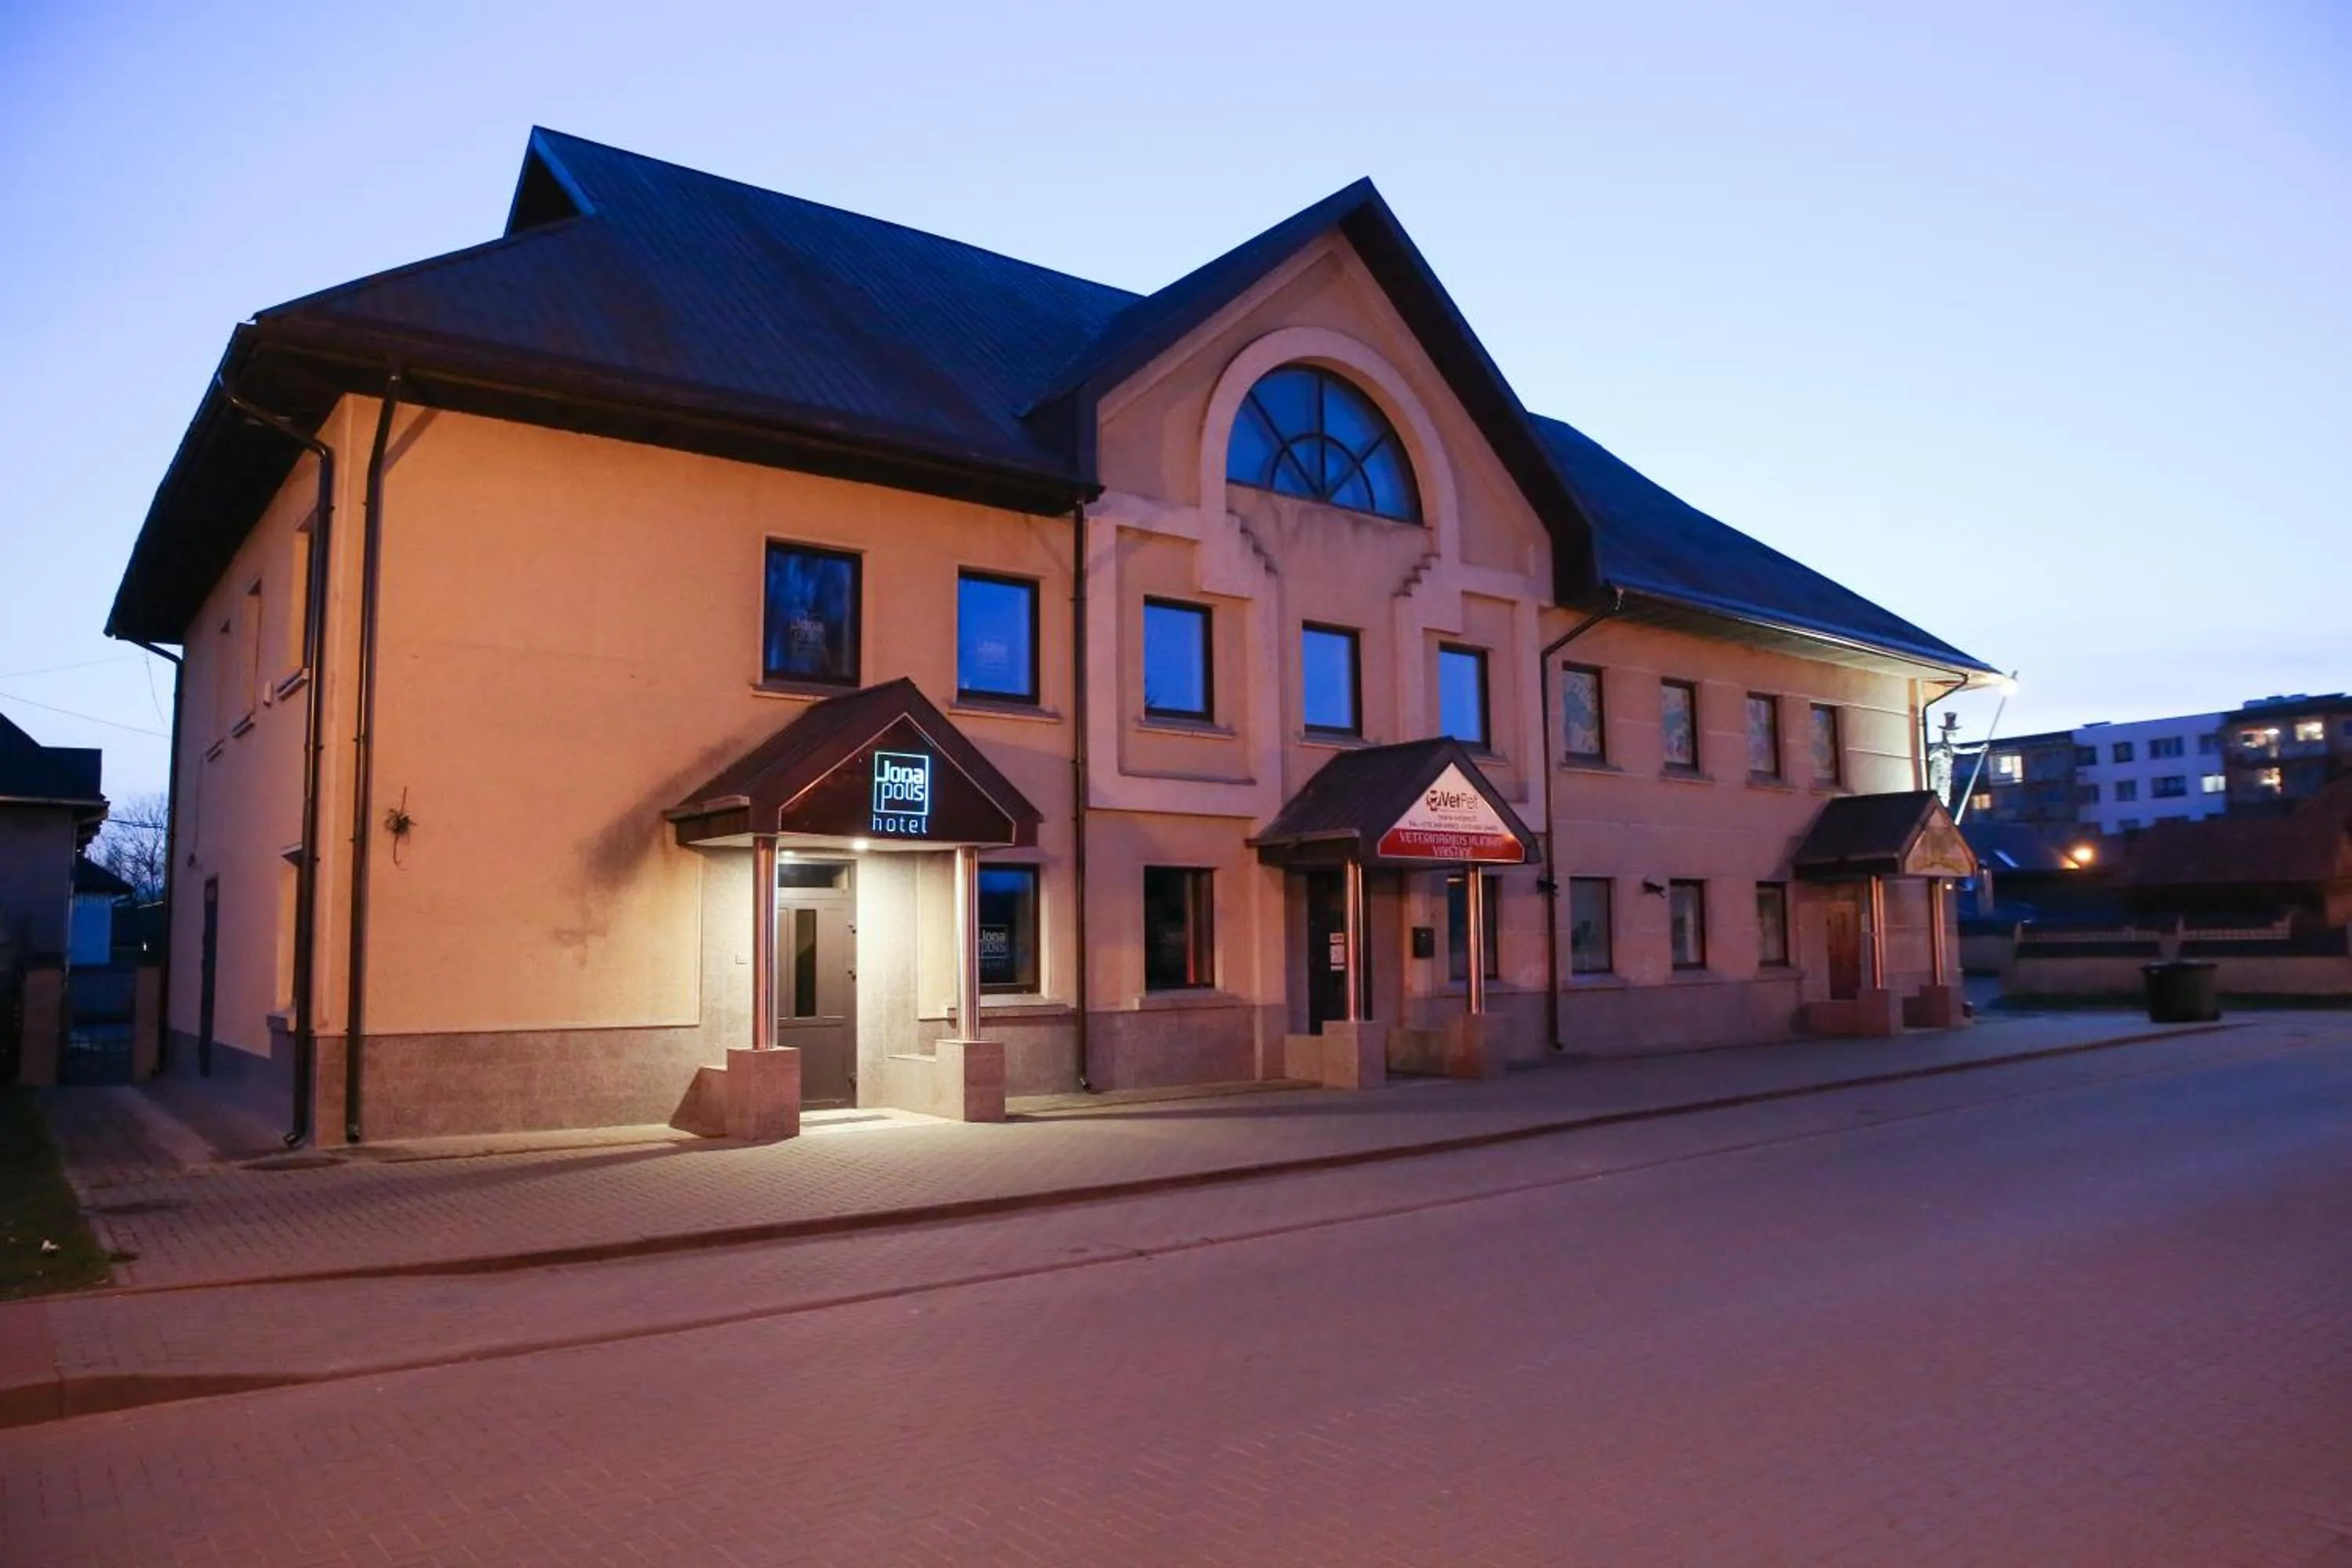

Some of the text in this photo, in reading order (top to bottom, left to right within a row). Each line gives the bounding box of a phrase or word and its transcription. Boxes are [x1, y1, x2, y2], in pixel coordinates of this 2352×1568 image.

[876, 760, 924, 784] Jona
[880, 781, 924, 811] polis
[873, 814, 927, 833] hotel
